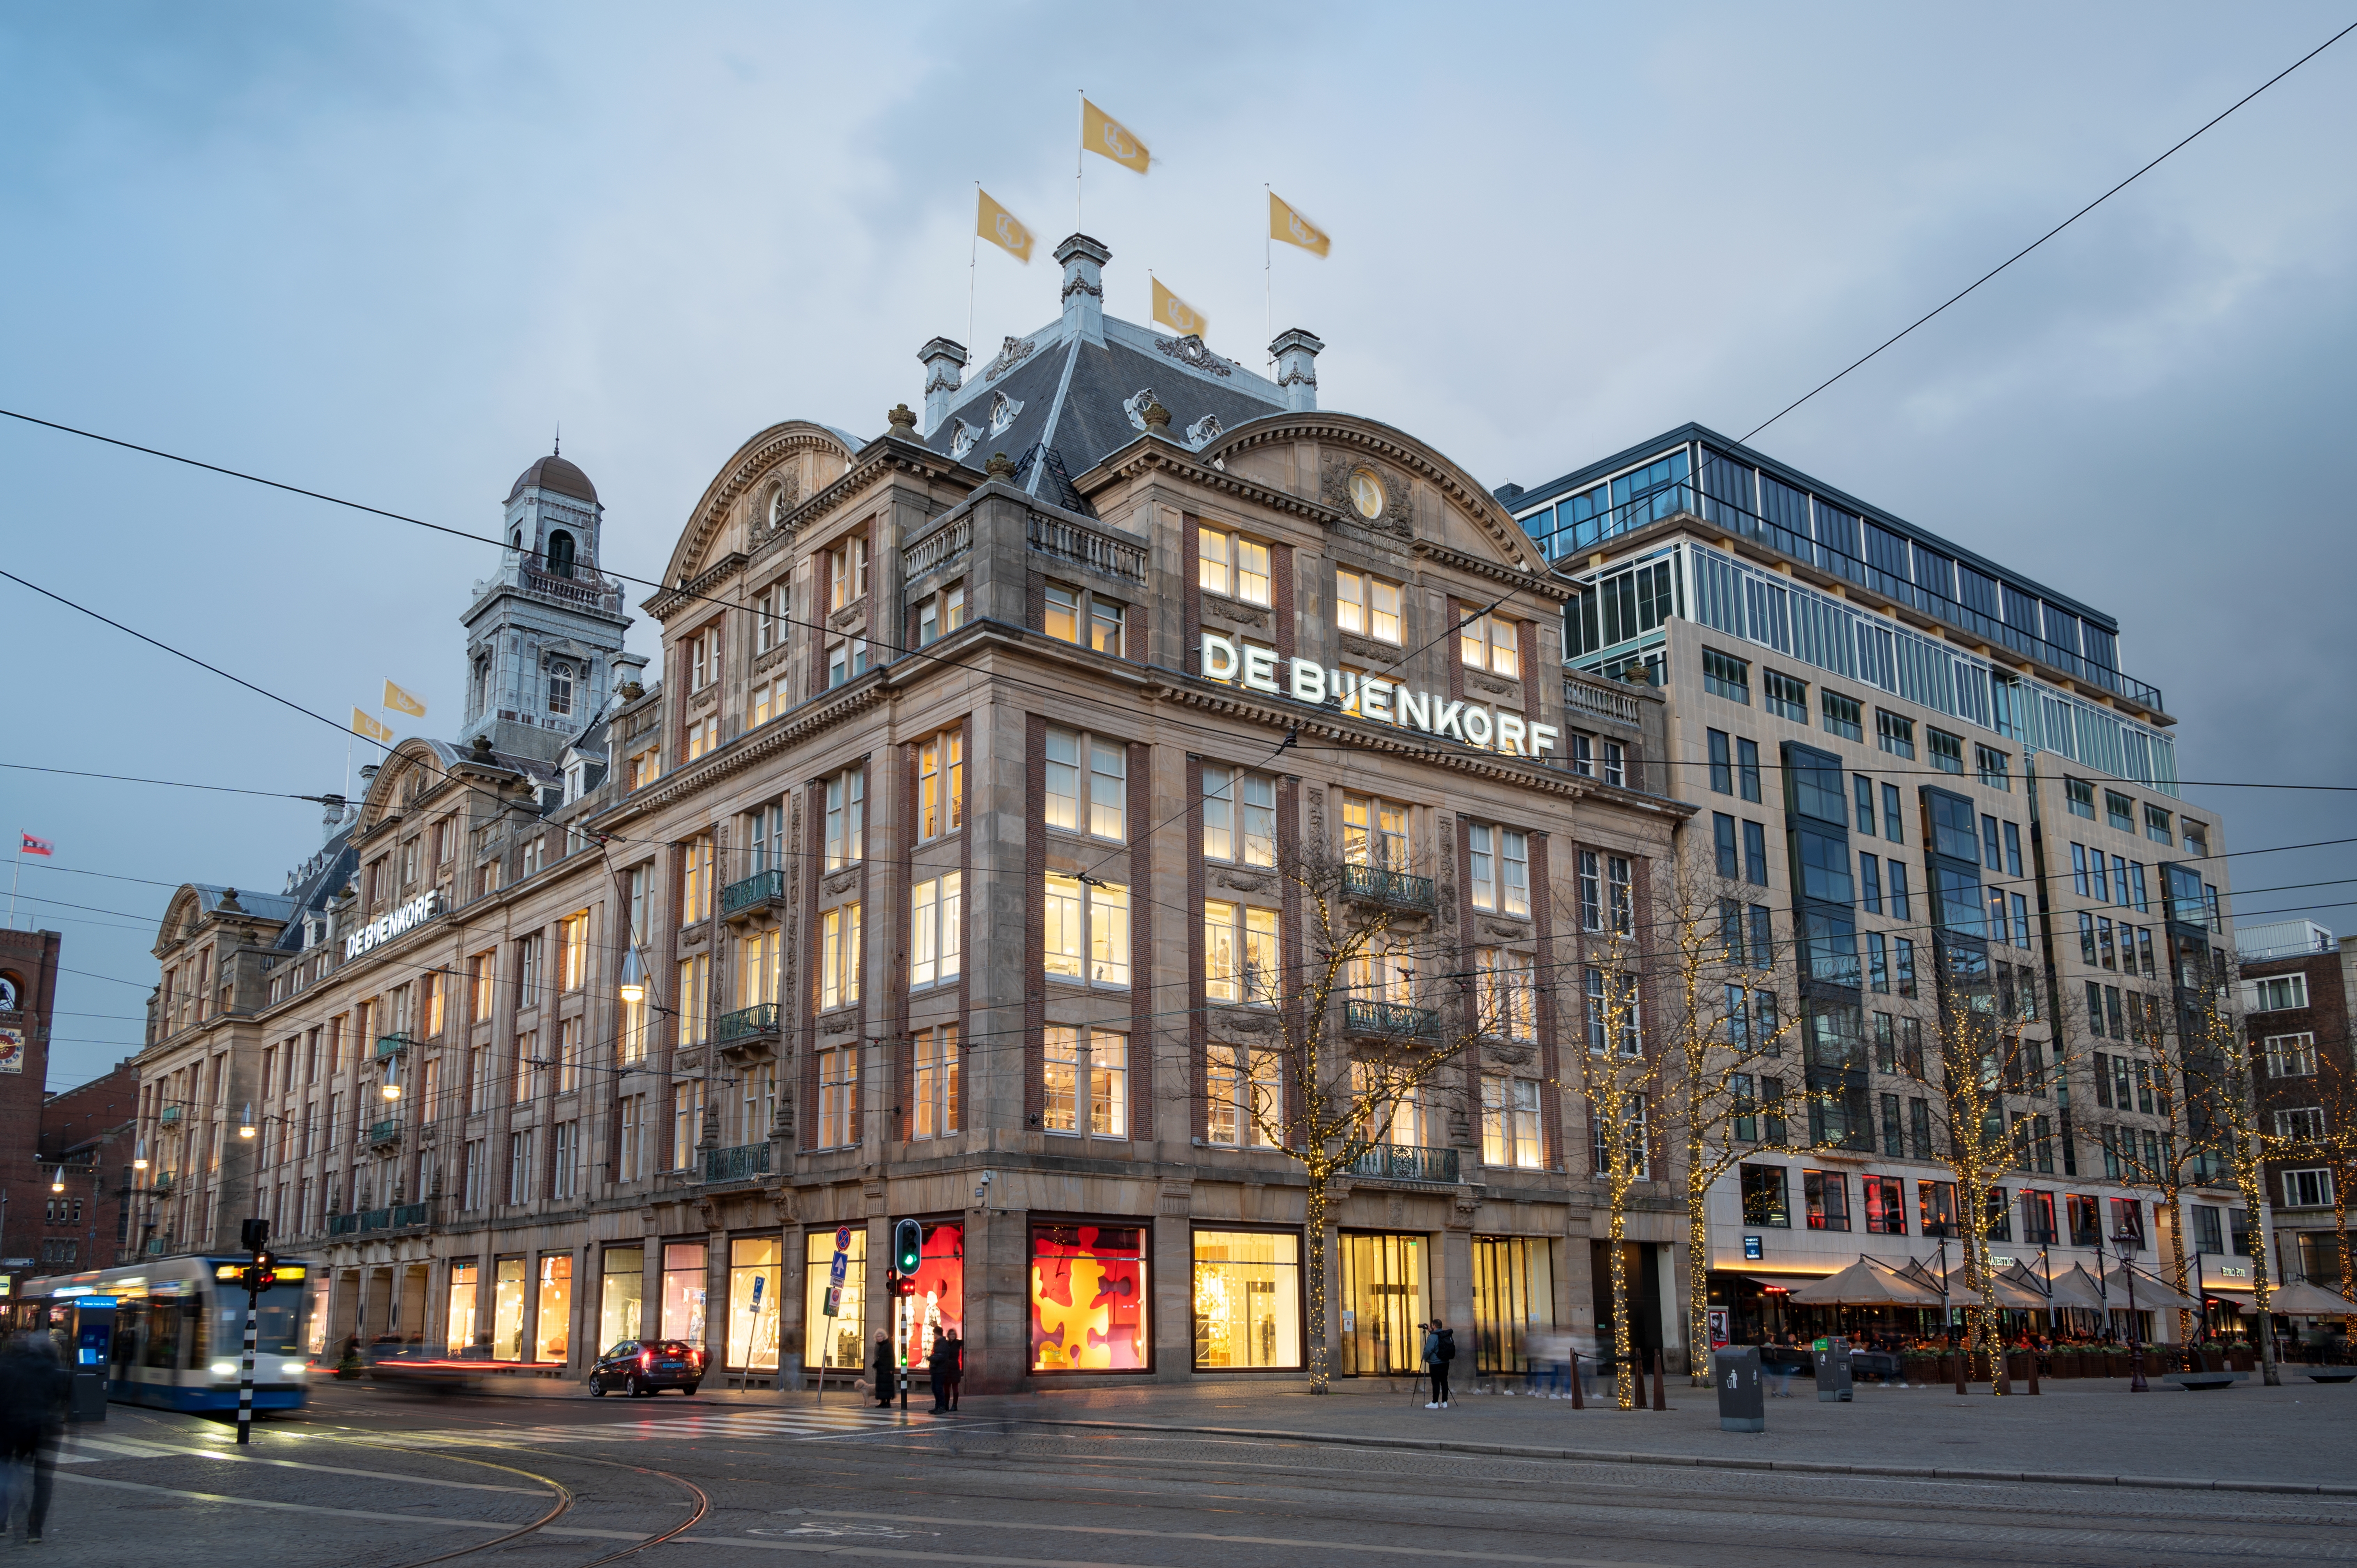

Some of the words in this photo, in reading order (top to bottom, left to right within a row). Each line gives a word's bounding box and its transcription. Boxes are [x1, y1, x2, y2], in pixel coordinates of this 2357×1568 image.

[1201, 632, 1279, 695] DE
[1290, 656, 1558, 758] BIJENKORF
[347, 928, 364, 960] DE
[364, 889, 438, 951] BIJENKORF
[2222, 1267, 2235, 1277] EURO
[2235, 1268, 2246, 1277] PUB
